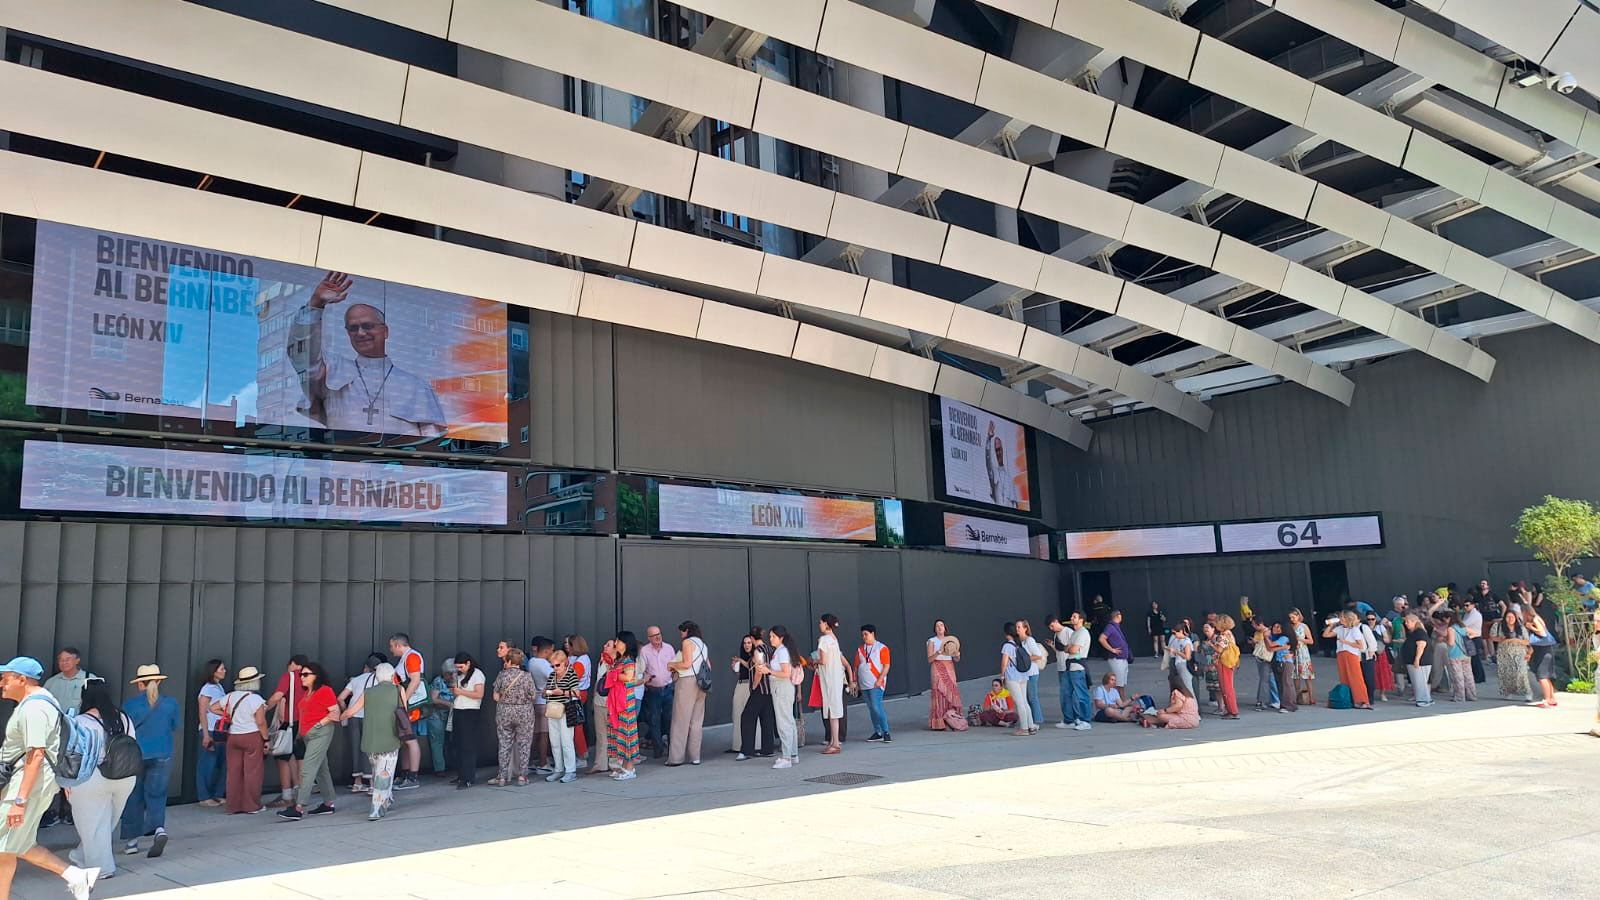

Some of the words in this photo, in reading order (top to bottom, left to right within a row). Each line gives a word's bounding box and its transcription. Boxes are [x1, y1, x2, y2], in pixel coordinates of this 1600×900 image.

[97, 235, 254, 285] BIENVENIDO
[94, 268, 128, 300] AL
[93, 312, 144, 340] LEÓN
[149, 318, 183, 344] XIV
[105, 464, 276, 503] BIENVENIDO
[282, 475, 312, 505] AL
[319, 476, 442, 510] BERNABÉU
[751, 502, 782, 528] LEÓN
[784, 506, 804, 528] XIV
[1277, 521, 1321, 547] 64
